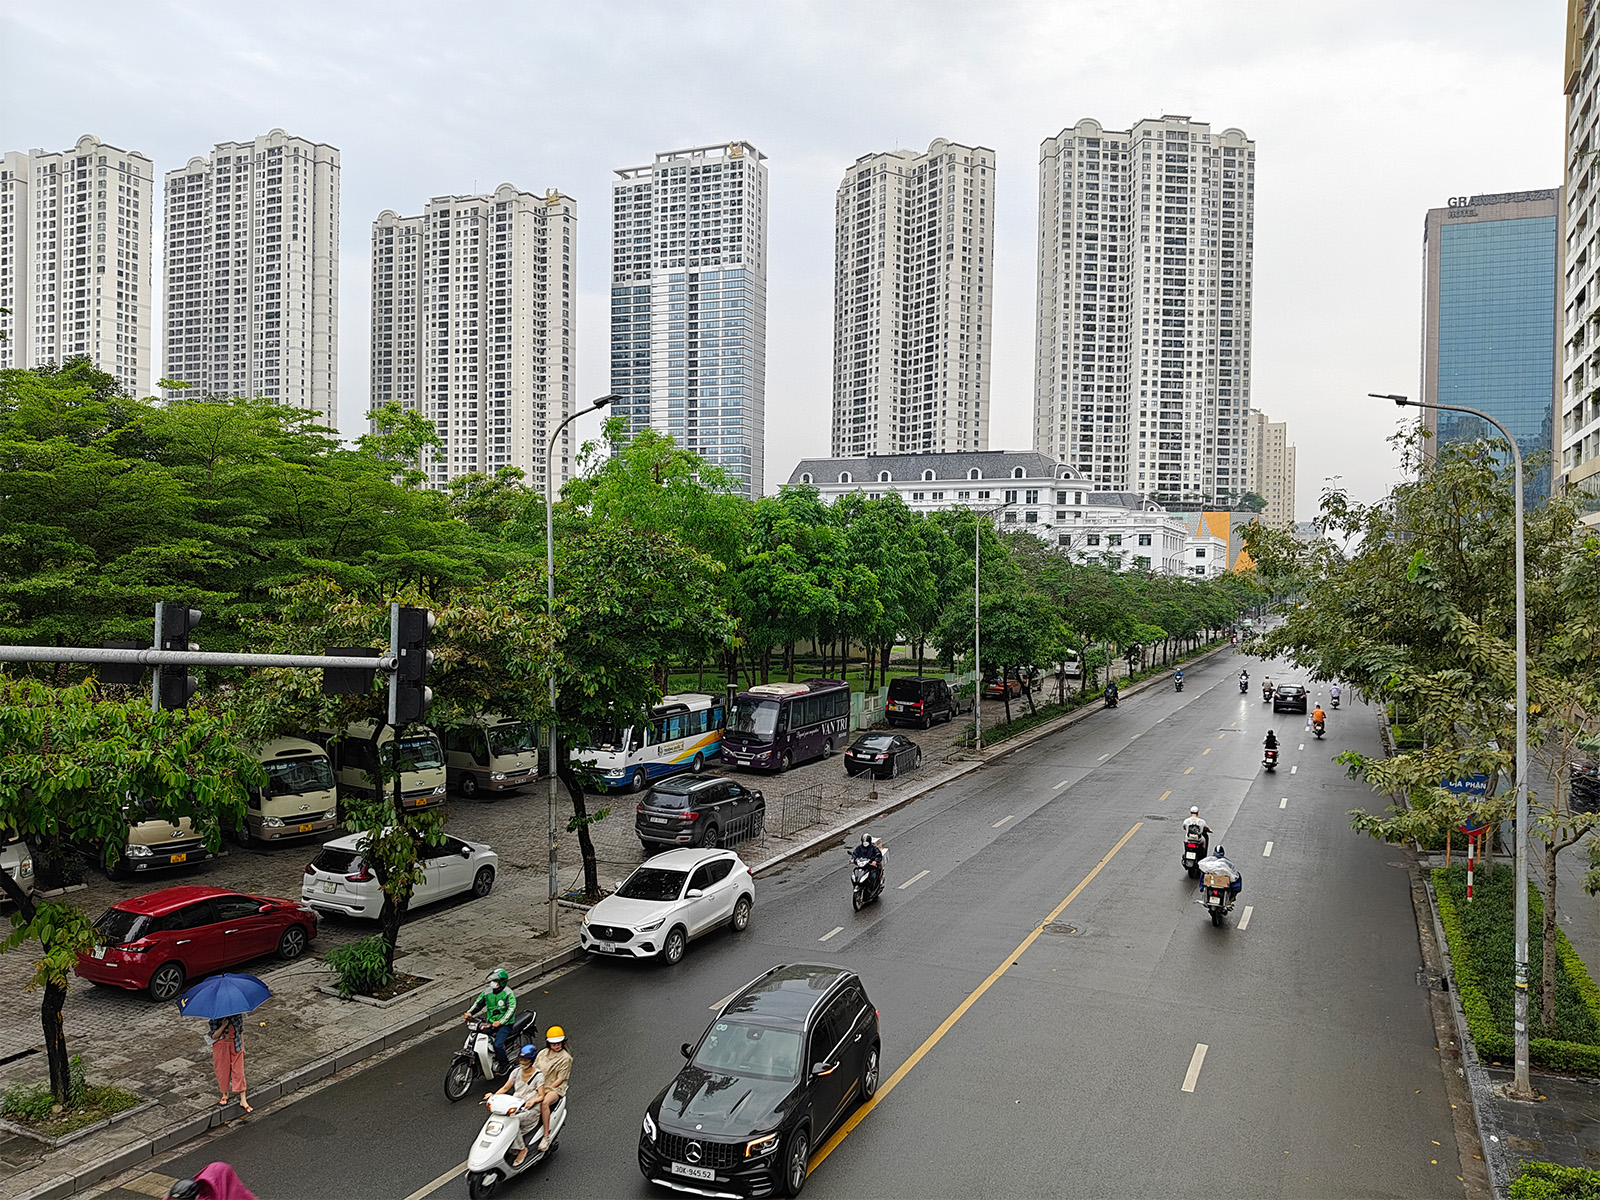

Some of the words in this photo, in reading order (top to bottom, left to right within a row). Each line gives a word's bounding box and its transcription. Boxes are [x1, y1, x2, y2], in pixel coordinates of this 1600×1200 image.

[1447, 193, 1499, 208] GRAND
[1504, 188, 1555, 204] PLAZA
[1447, 208, 1478, 219] HOTEL
[675, 1165, 712, 1179] 30K-945.52
